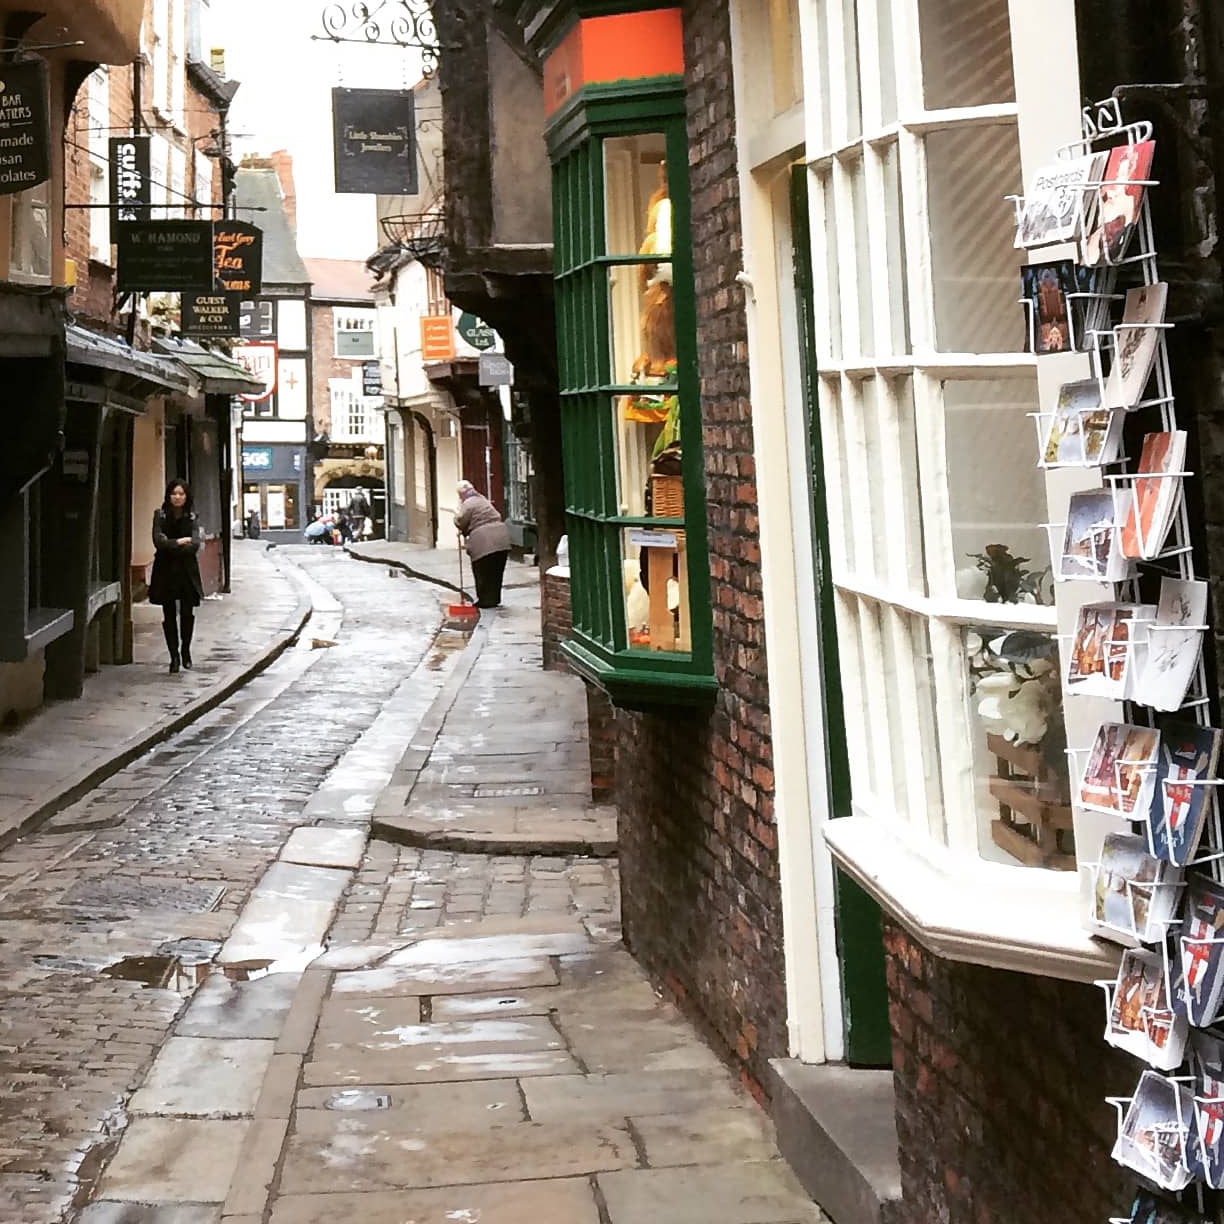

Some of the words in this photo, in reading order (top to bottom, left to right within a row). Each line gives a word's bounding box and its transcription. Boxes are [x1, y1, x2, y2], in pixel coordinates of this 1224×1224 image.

[2, 94, 22, 107] BAR
[122, 143, 142, 198] cuffs
[214, 242, 243, 270] Tea
[196, 296, 226, 304] GUEST
[192, 306, 229, 314] WALKER
[208, 315, 223, 323] CO
